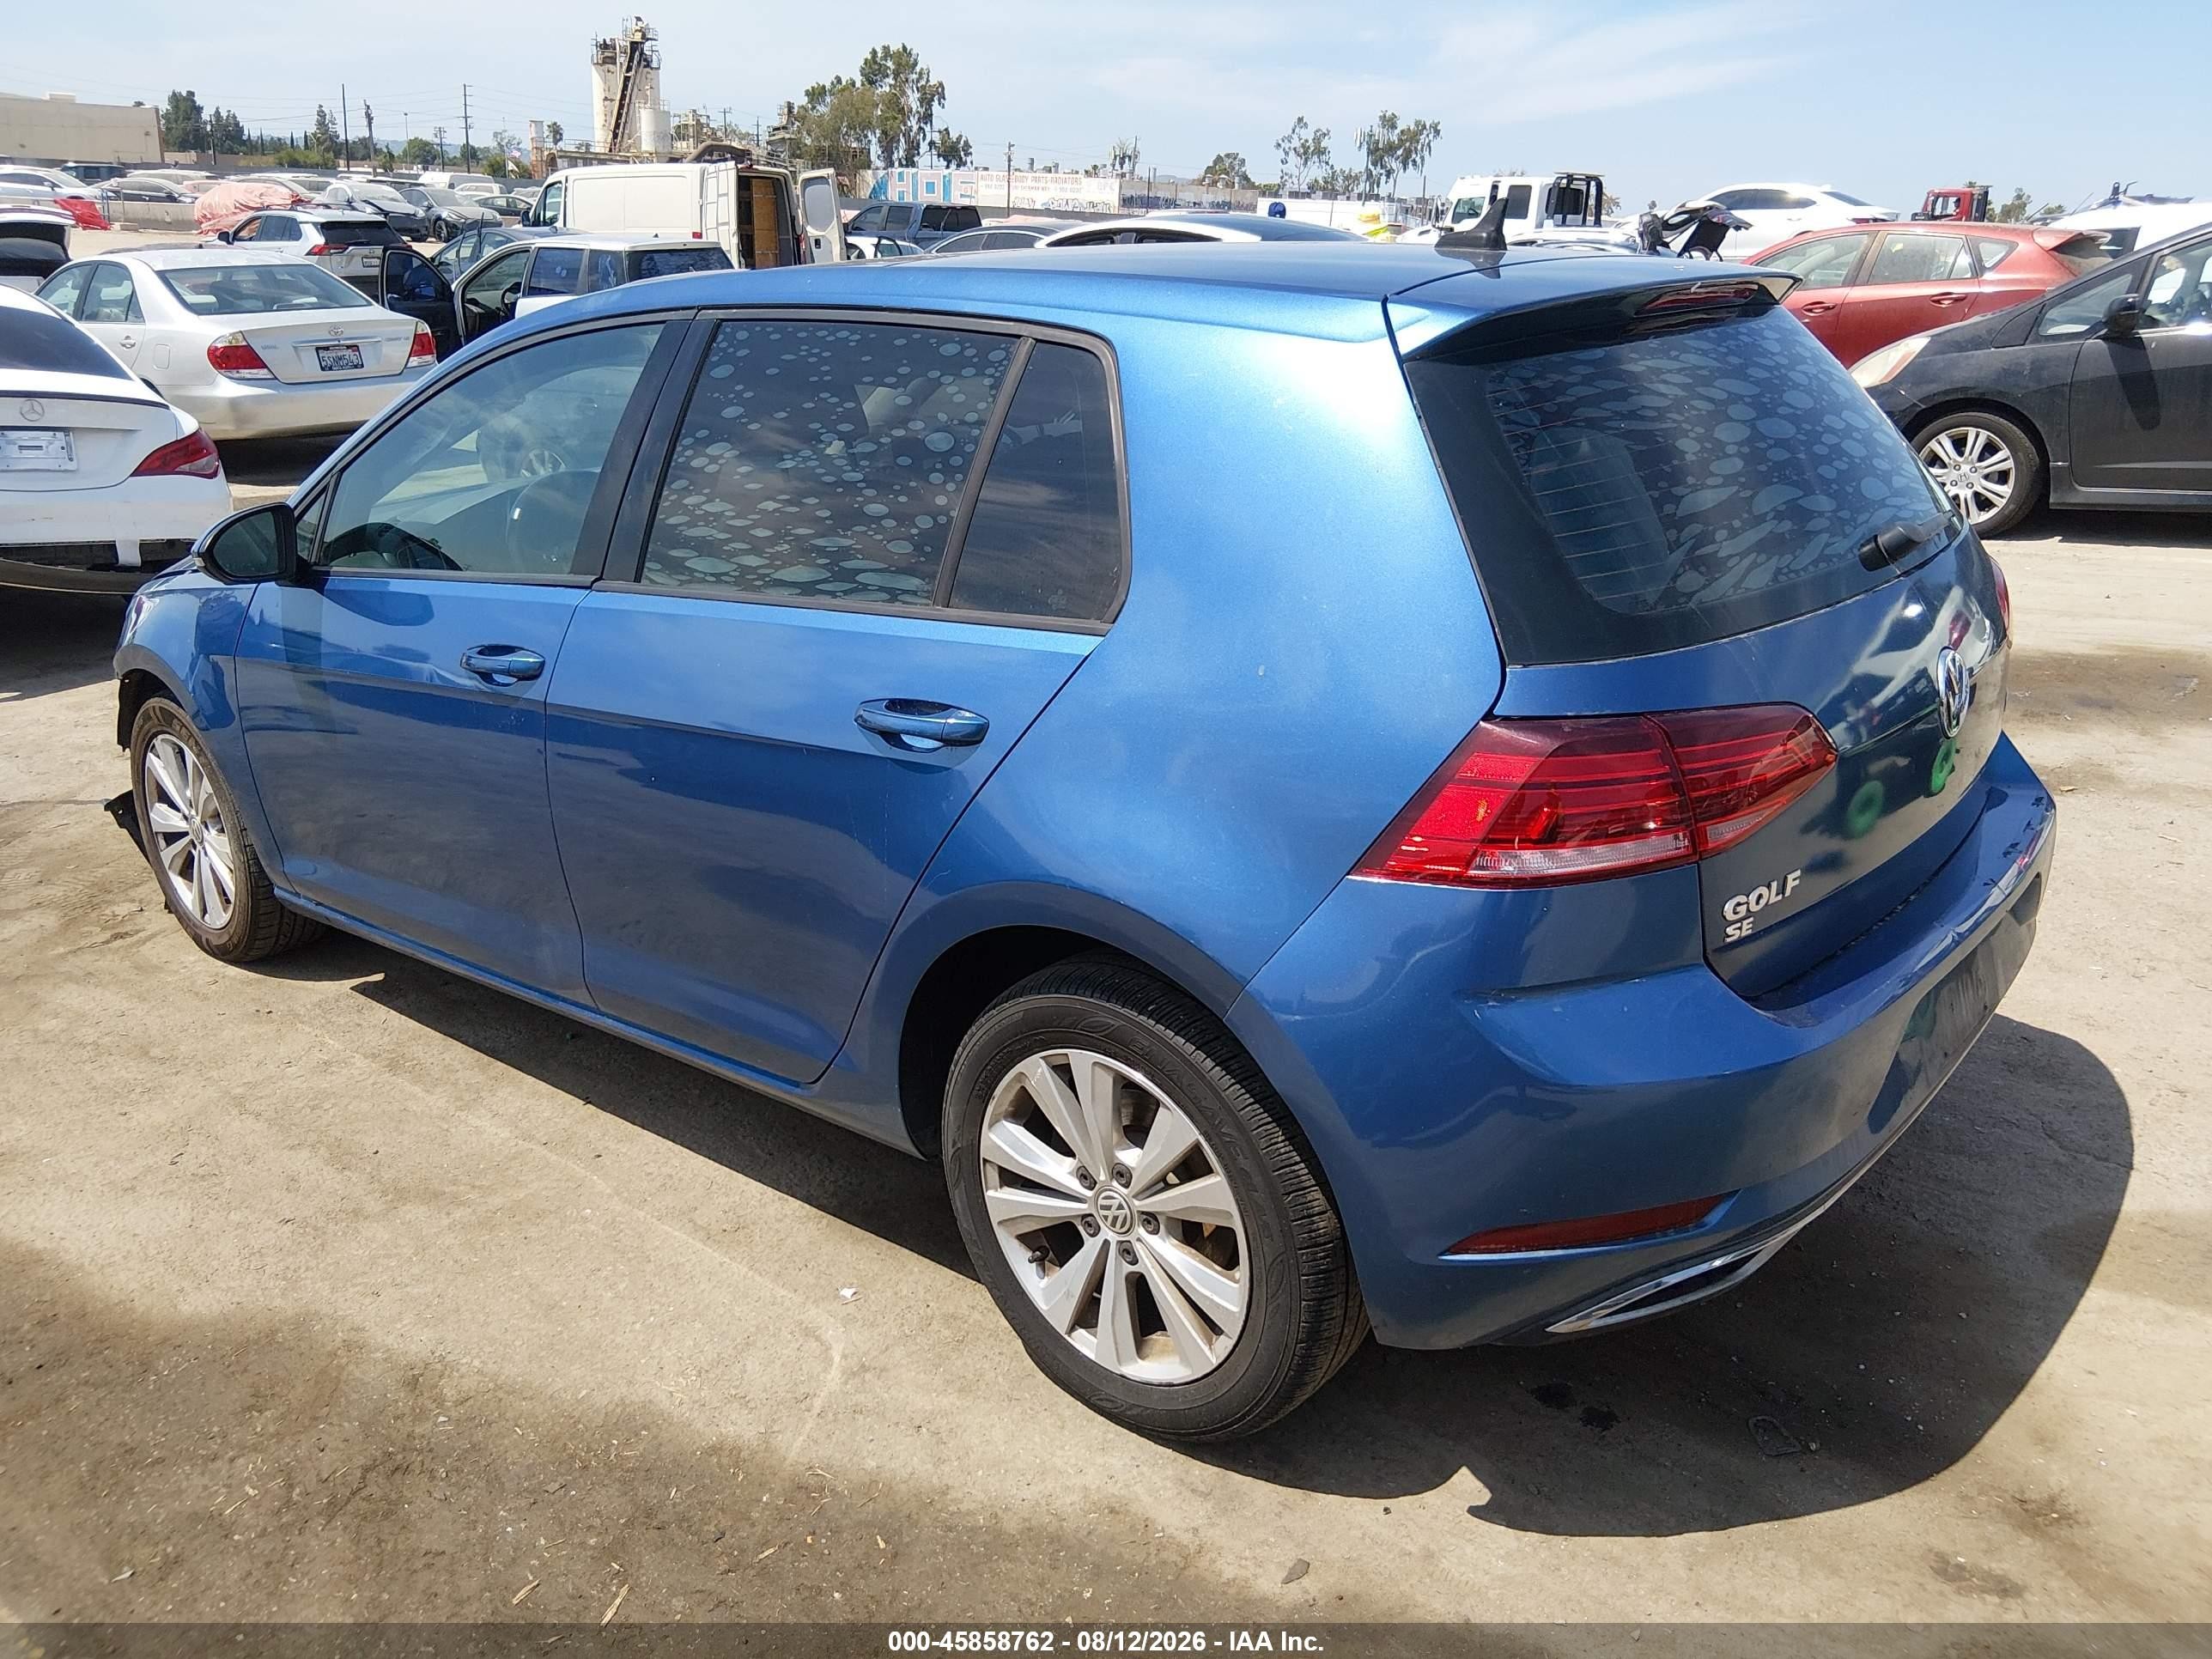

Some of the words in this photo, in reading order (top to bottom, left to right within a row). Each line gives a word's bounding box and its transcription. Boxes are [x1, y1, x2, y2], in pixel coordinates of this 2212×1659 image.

[980, 173, 994, 182] AUTO
[321, 354, 360, 367] 5SNM543
[1723, 869, 1802, 921] GOLF
[1724, 917, 1753, 942] SE
